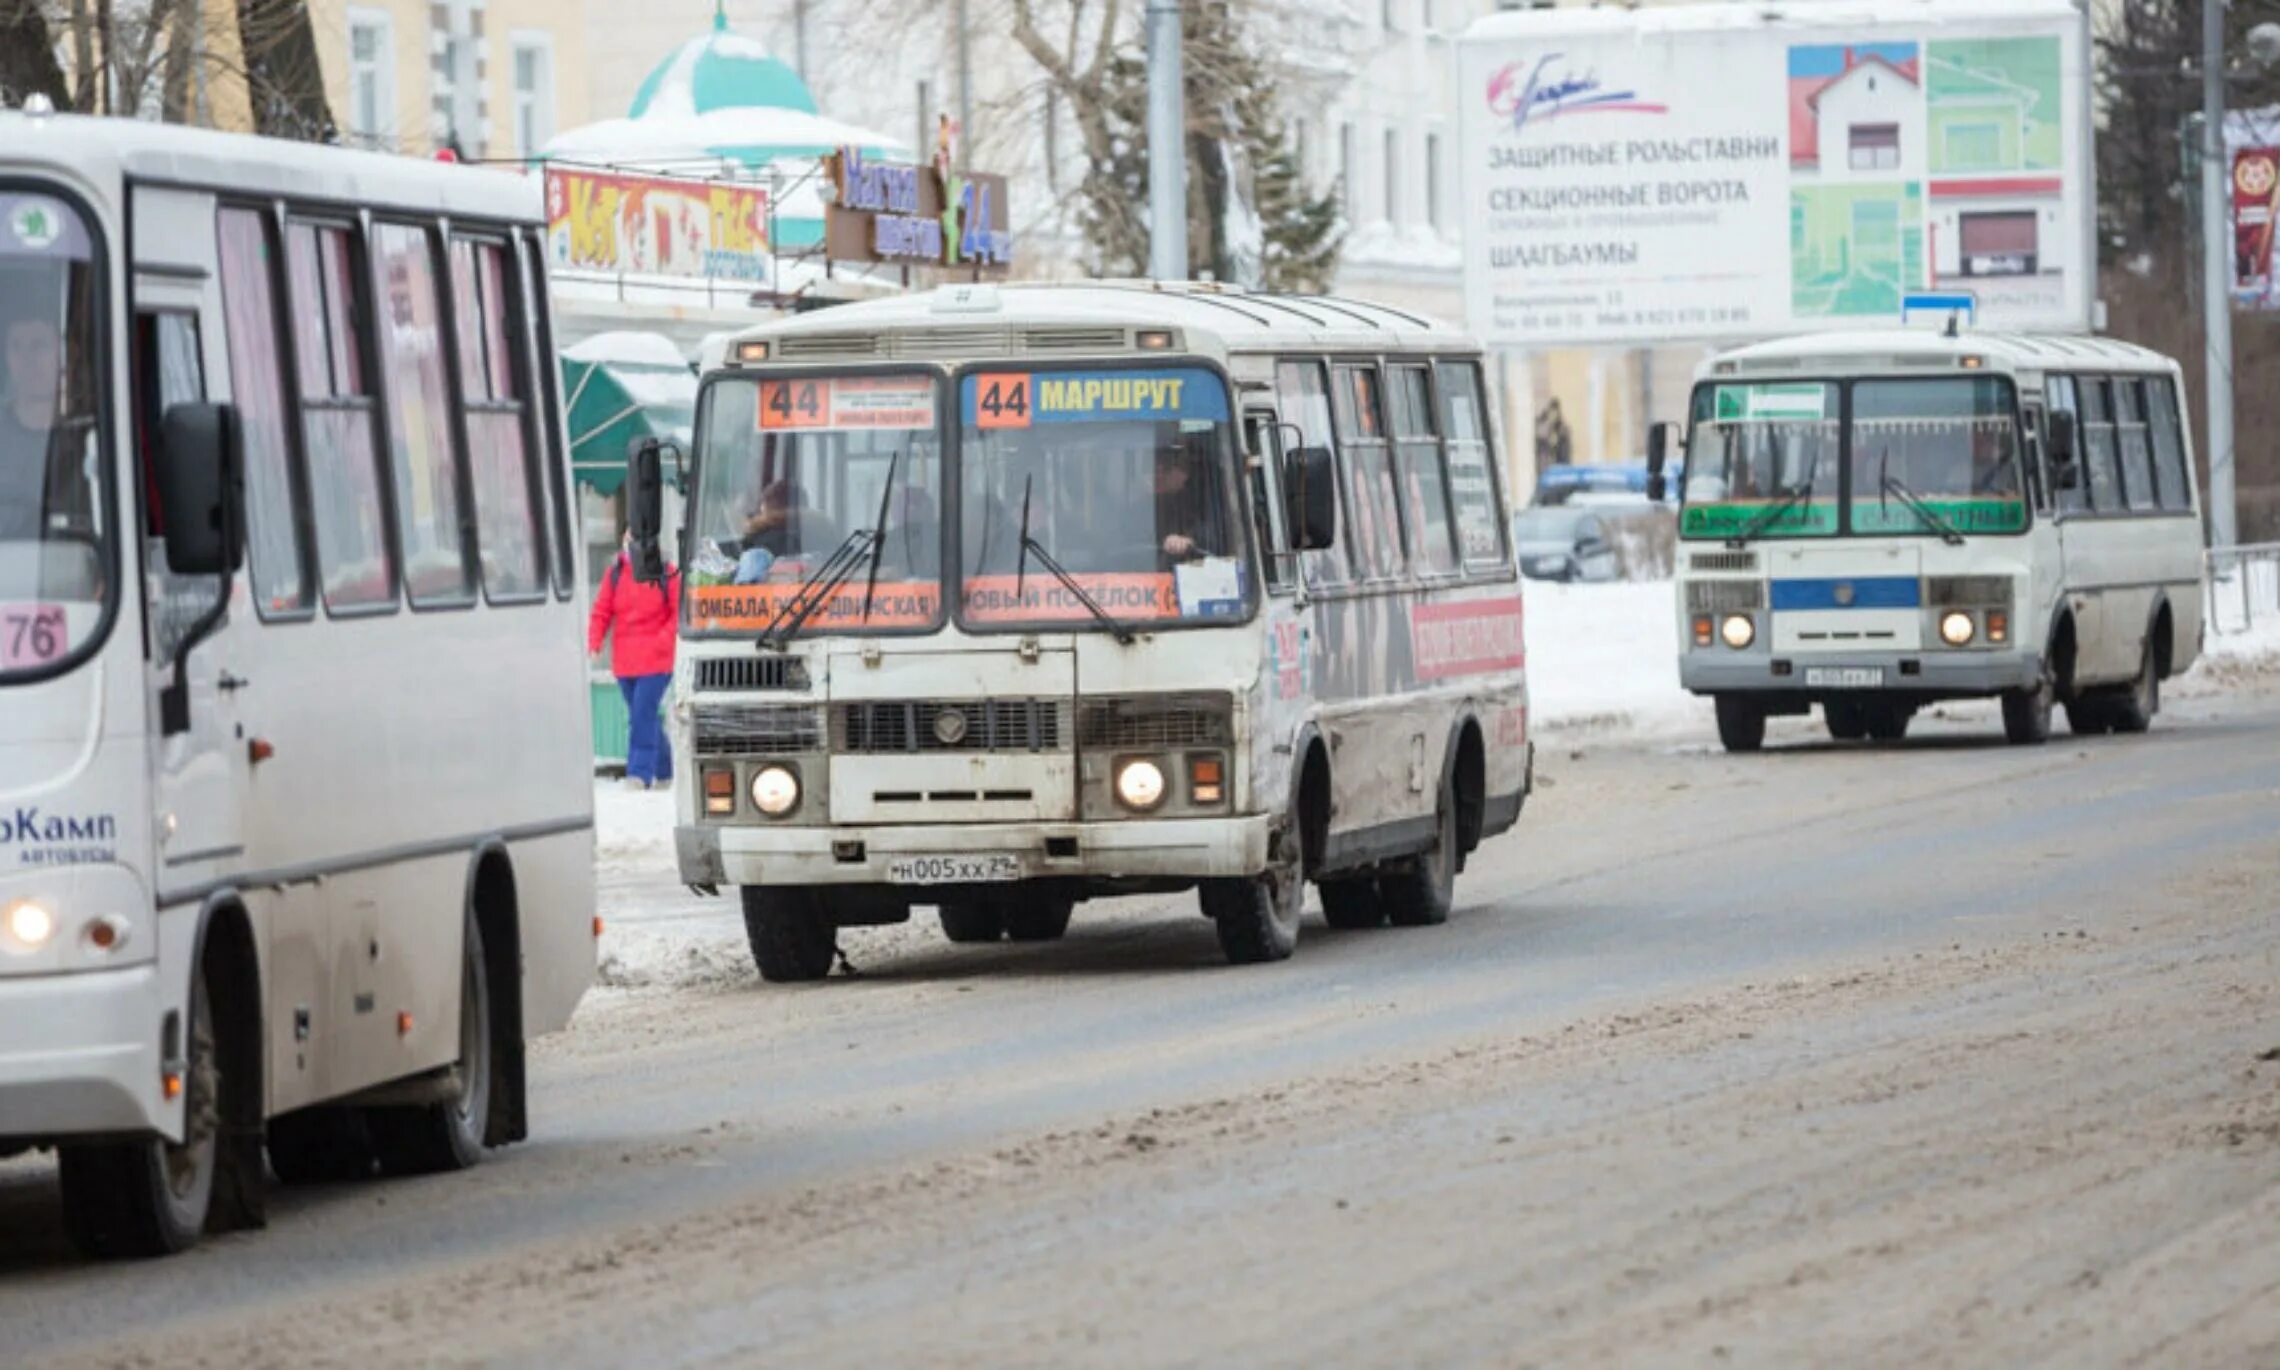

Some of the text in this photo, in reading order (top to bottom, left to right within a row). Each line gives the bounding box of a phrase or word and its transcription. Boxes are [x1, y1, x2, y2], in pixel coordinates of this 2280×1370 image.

[1488, 136, 1780, 169] ЗАЩИТНЫЕ РОЛЬСТАВНИ
[1488, 180, 1749, 212] СЕКЦИОННЫЕ ВОРОТА
[1489, 242, 1638, 269] ШЛАГБАУМЫ
[770, 377, 820, 418] 44
[981, 380, 1184, 417] 44 МАРШРУТ
